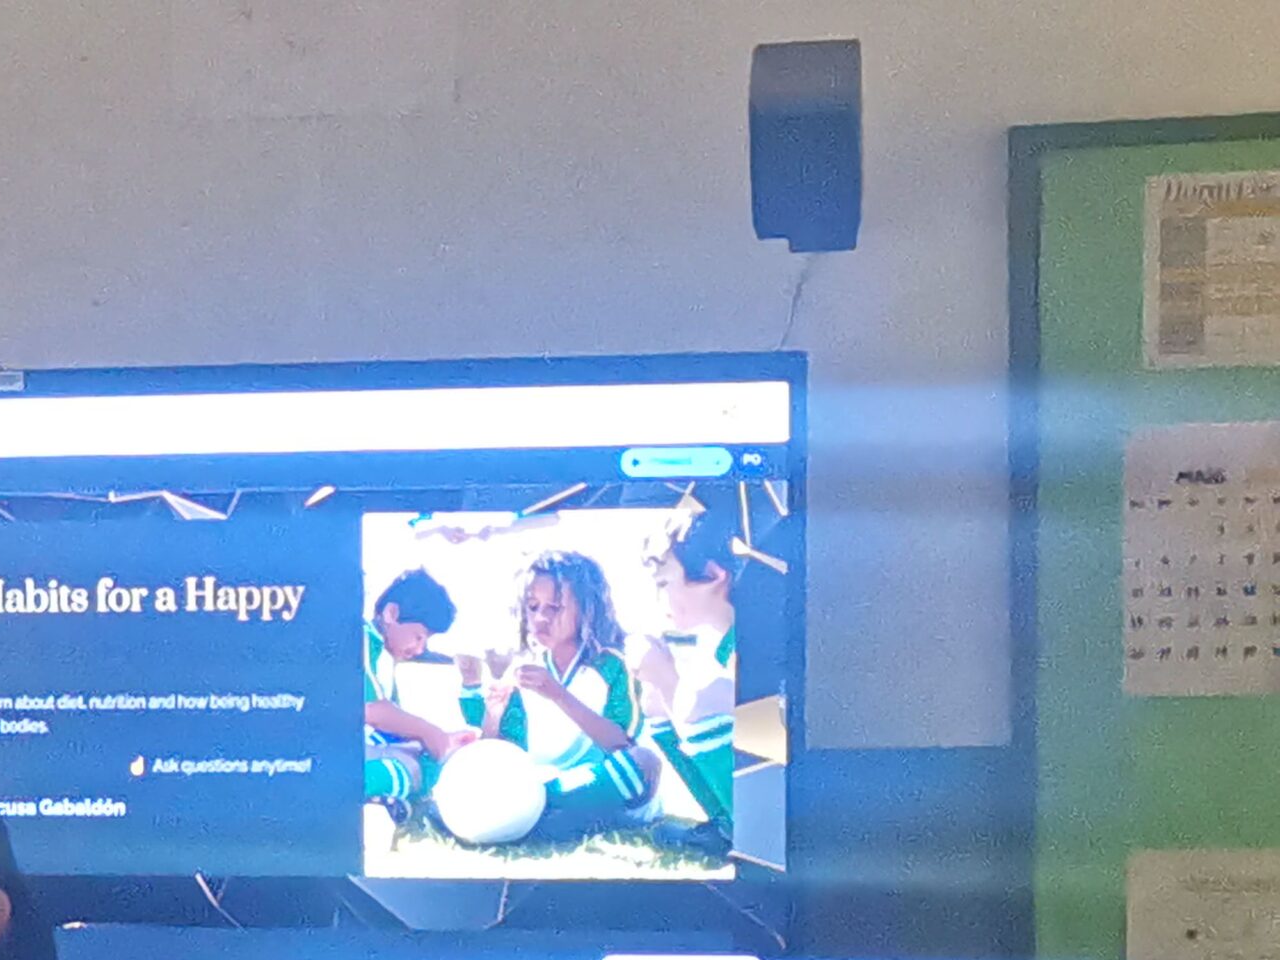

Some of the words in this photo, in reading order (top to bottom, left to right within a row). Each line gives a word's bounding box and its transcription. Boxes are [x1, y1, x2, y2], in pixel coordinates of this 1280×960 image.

[96, 577, 148, 614] for
[154, 587, 177, 613] a
[185, 576, 305, 621] Happy
[15, 695, 56, 710] about
[89, 694, 147, 710] nutrition
[148, 694, 176, 710] and
[177, 694, 208, 710] how
[209, 694, 250, 712] being
[252, 693, 306, 712] healthy
[152, 758, 179, 773] Ask
[180, 758, 249, 775] questions
